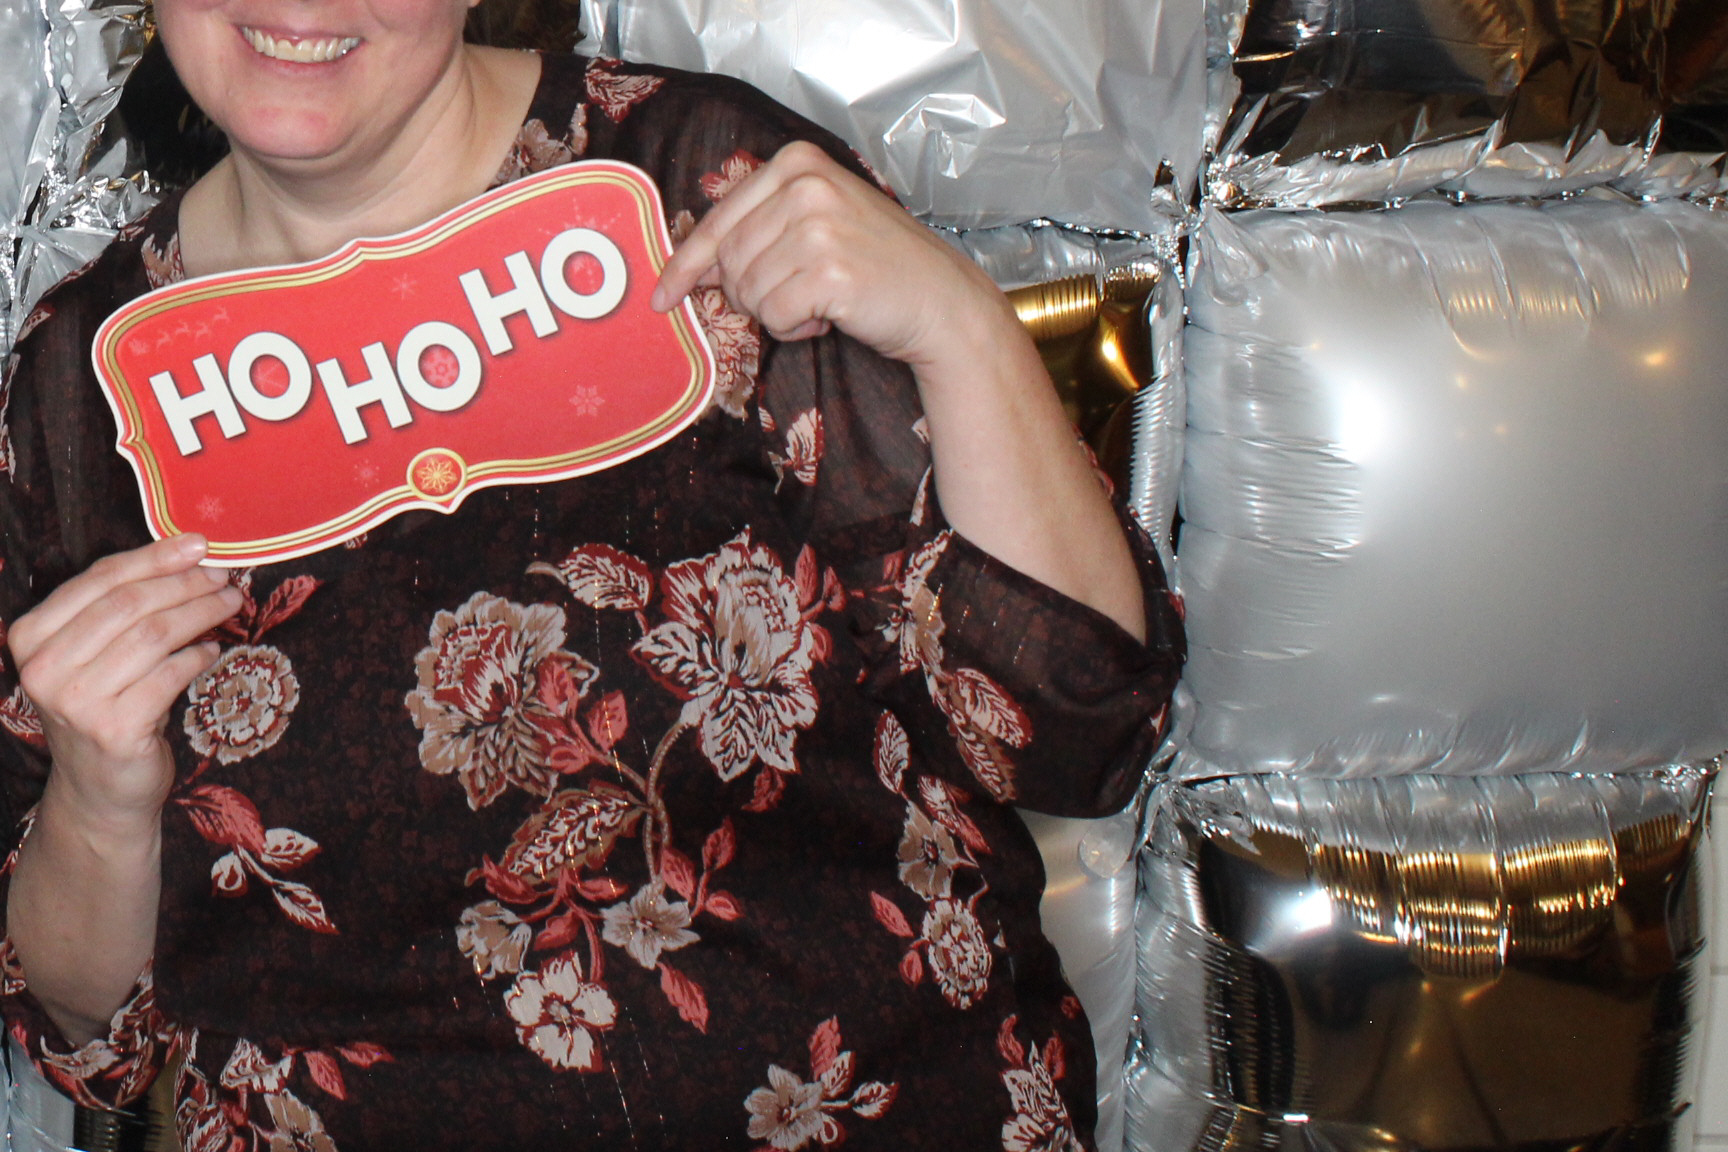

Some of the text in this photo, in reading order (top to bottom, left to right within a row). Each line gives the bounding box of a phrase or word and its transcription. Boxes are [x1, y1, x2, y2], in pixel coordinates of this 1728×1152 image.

[149, 228, 627, 457] HO HO HO
